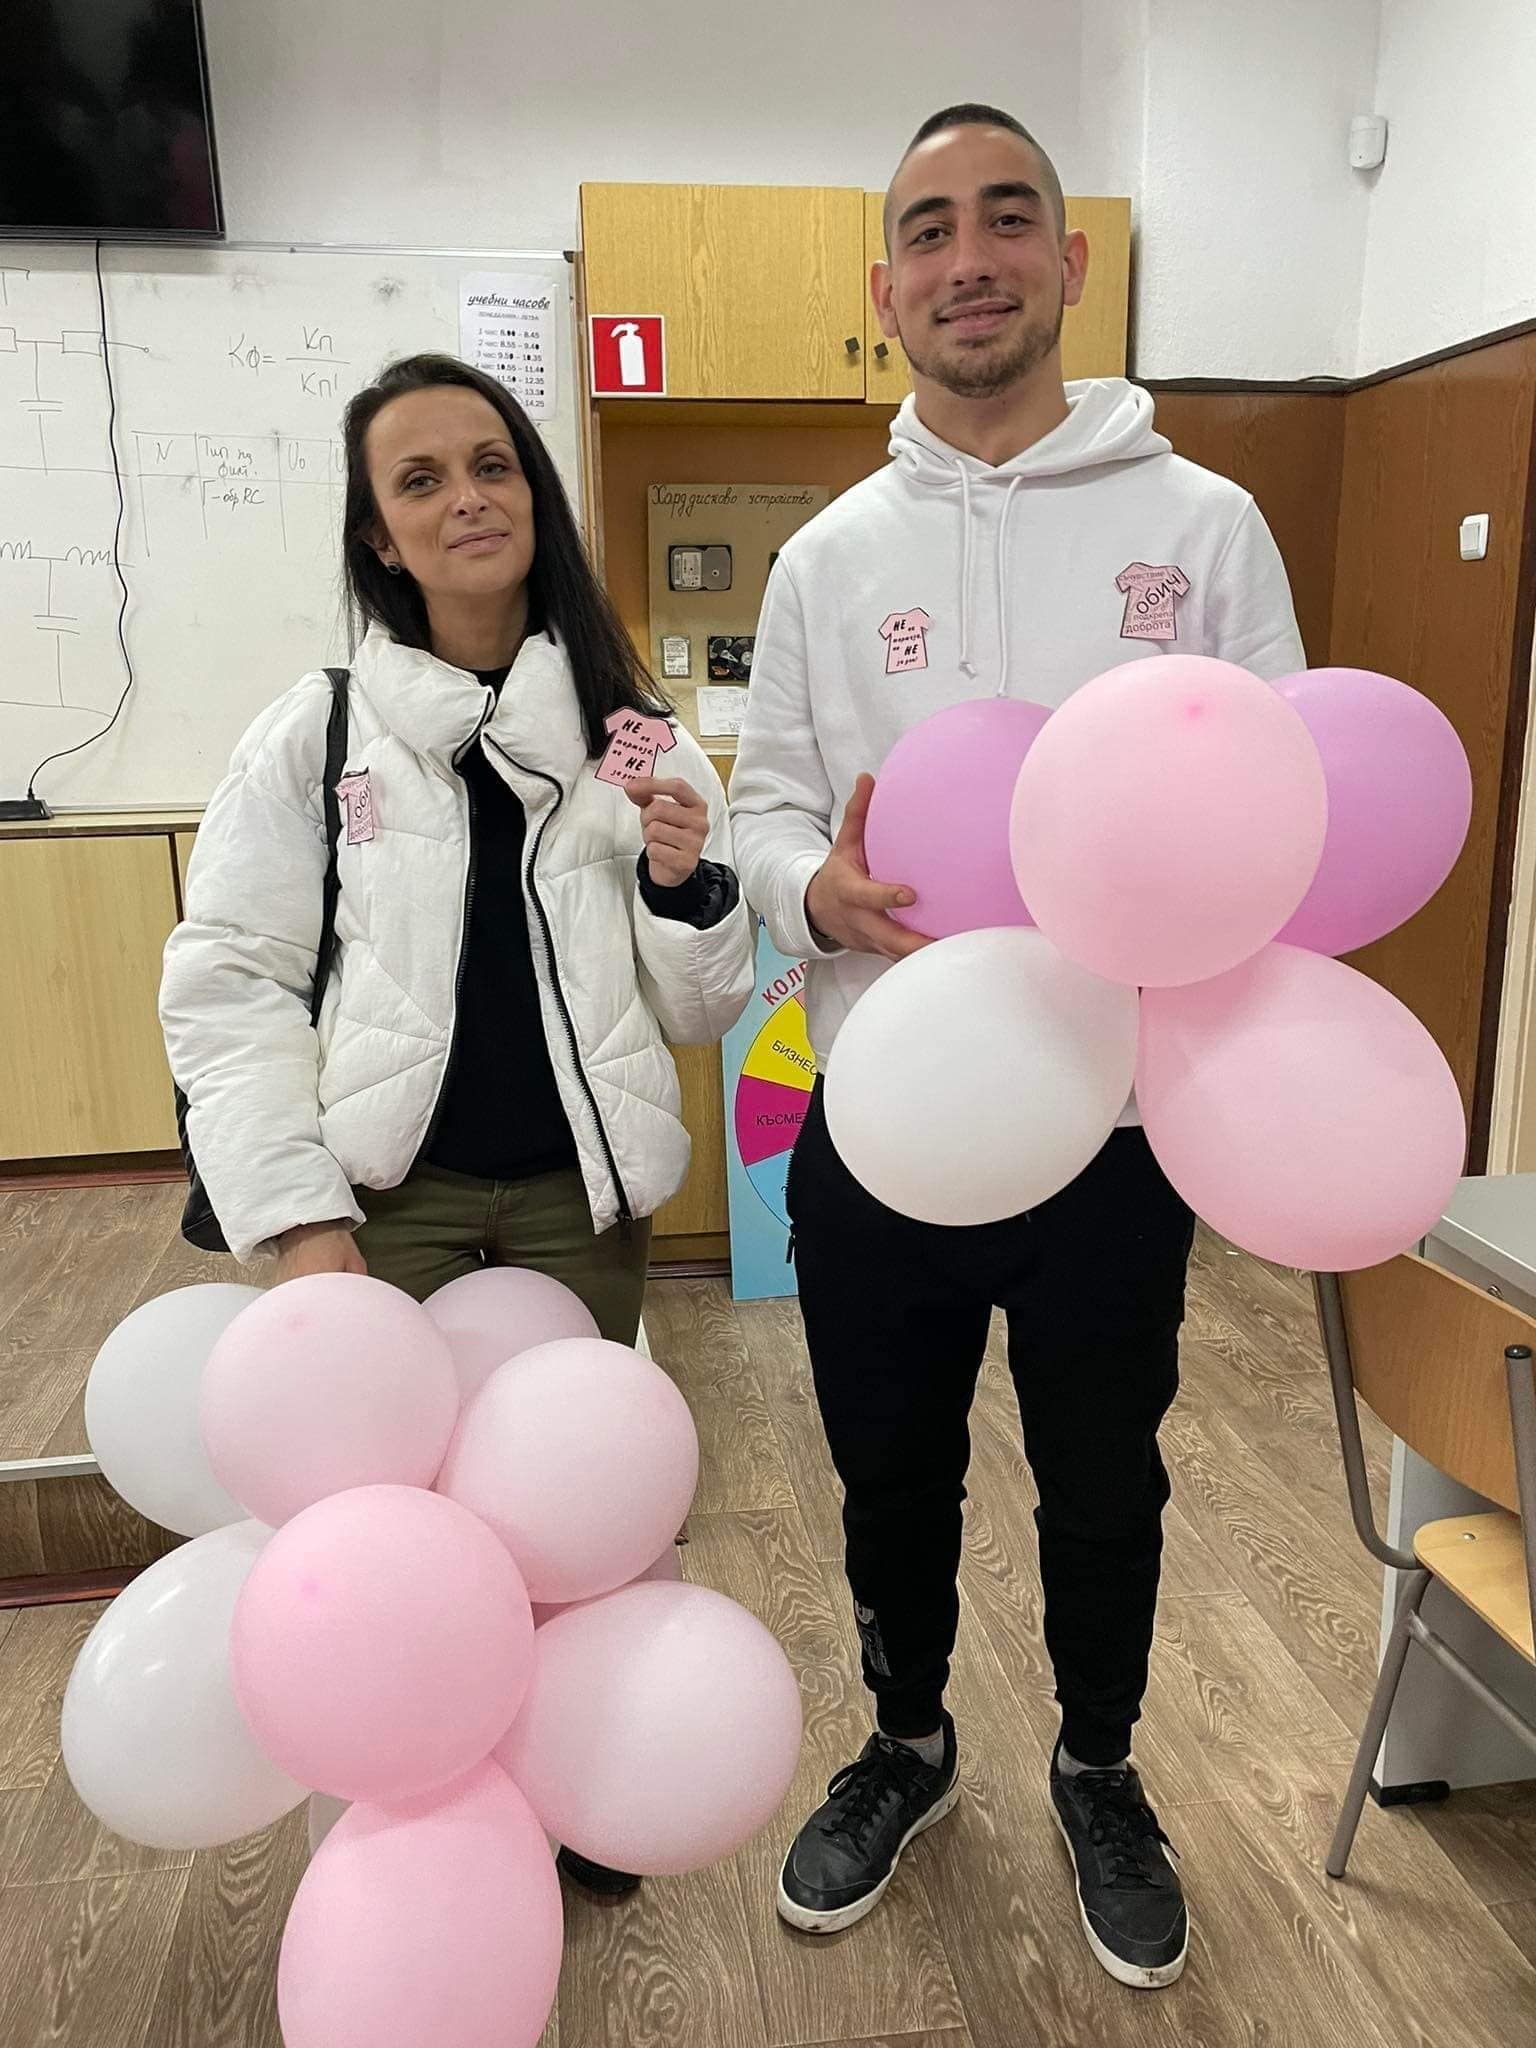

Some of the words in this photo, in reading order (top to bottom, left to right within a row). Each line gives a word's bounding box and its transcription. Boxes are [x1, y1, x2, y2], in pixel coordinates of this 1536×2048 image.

[467, 293, 507, 306] учебни
[512, 296, 550, 310] часове
[893, 619, 906, 632] НЕ
[1126, 621, 1171, 634] доброта
[904, 644, 919, 656] НЕ
[622, 719, 643, 734] НЕ
[625, 757, 646, 771] НЕ
[771, 1040, 817, 1076] БИЗНЕС
